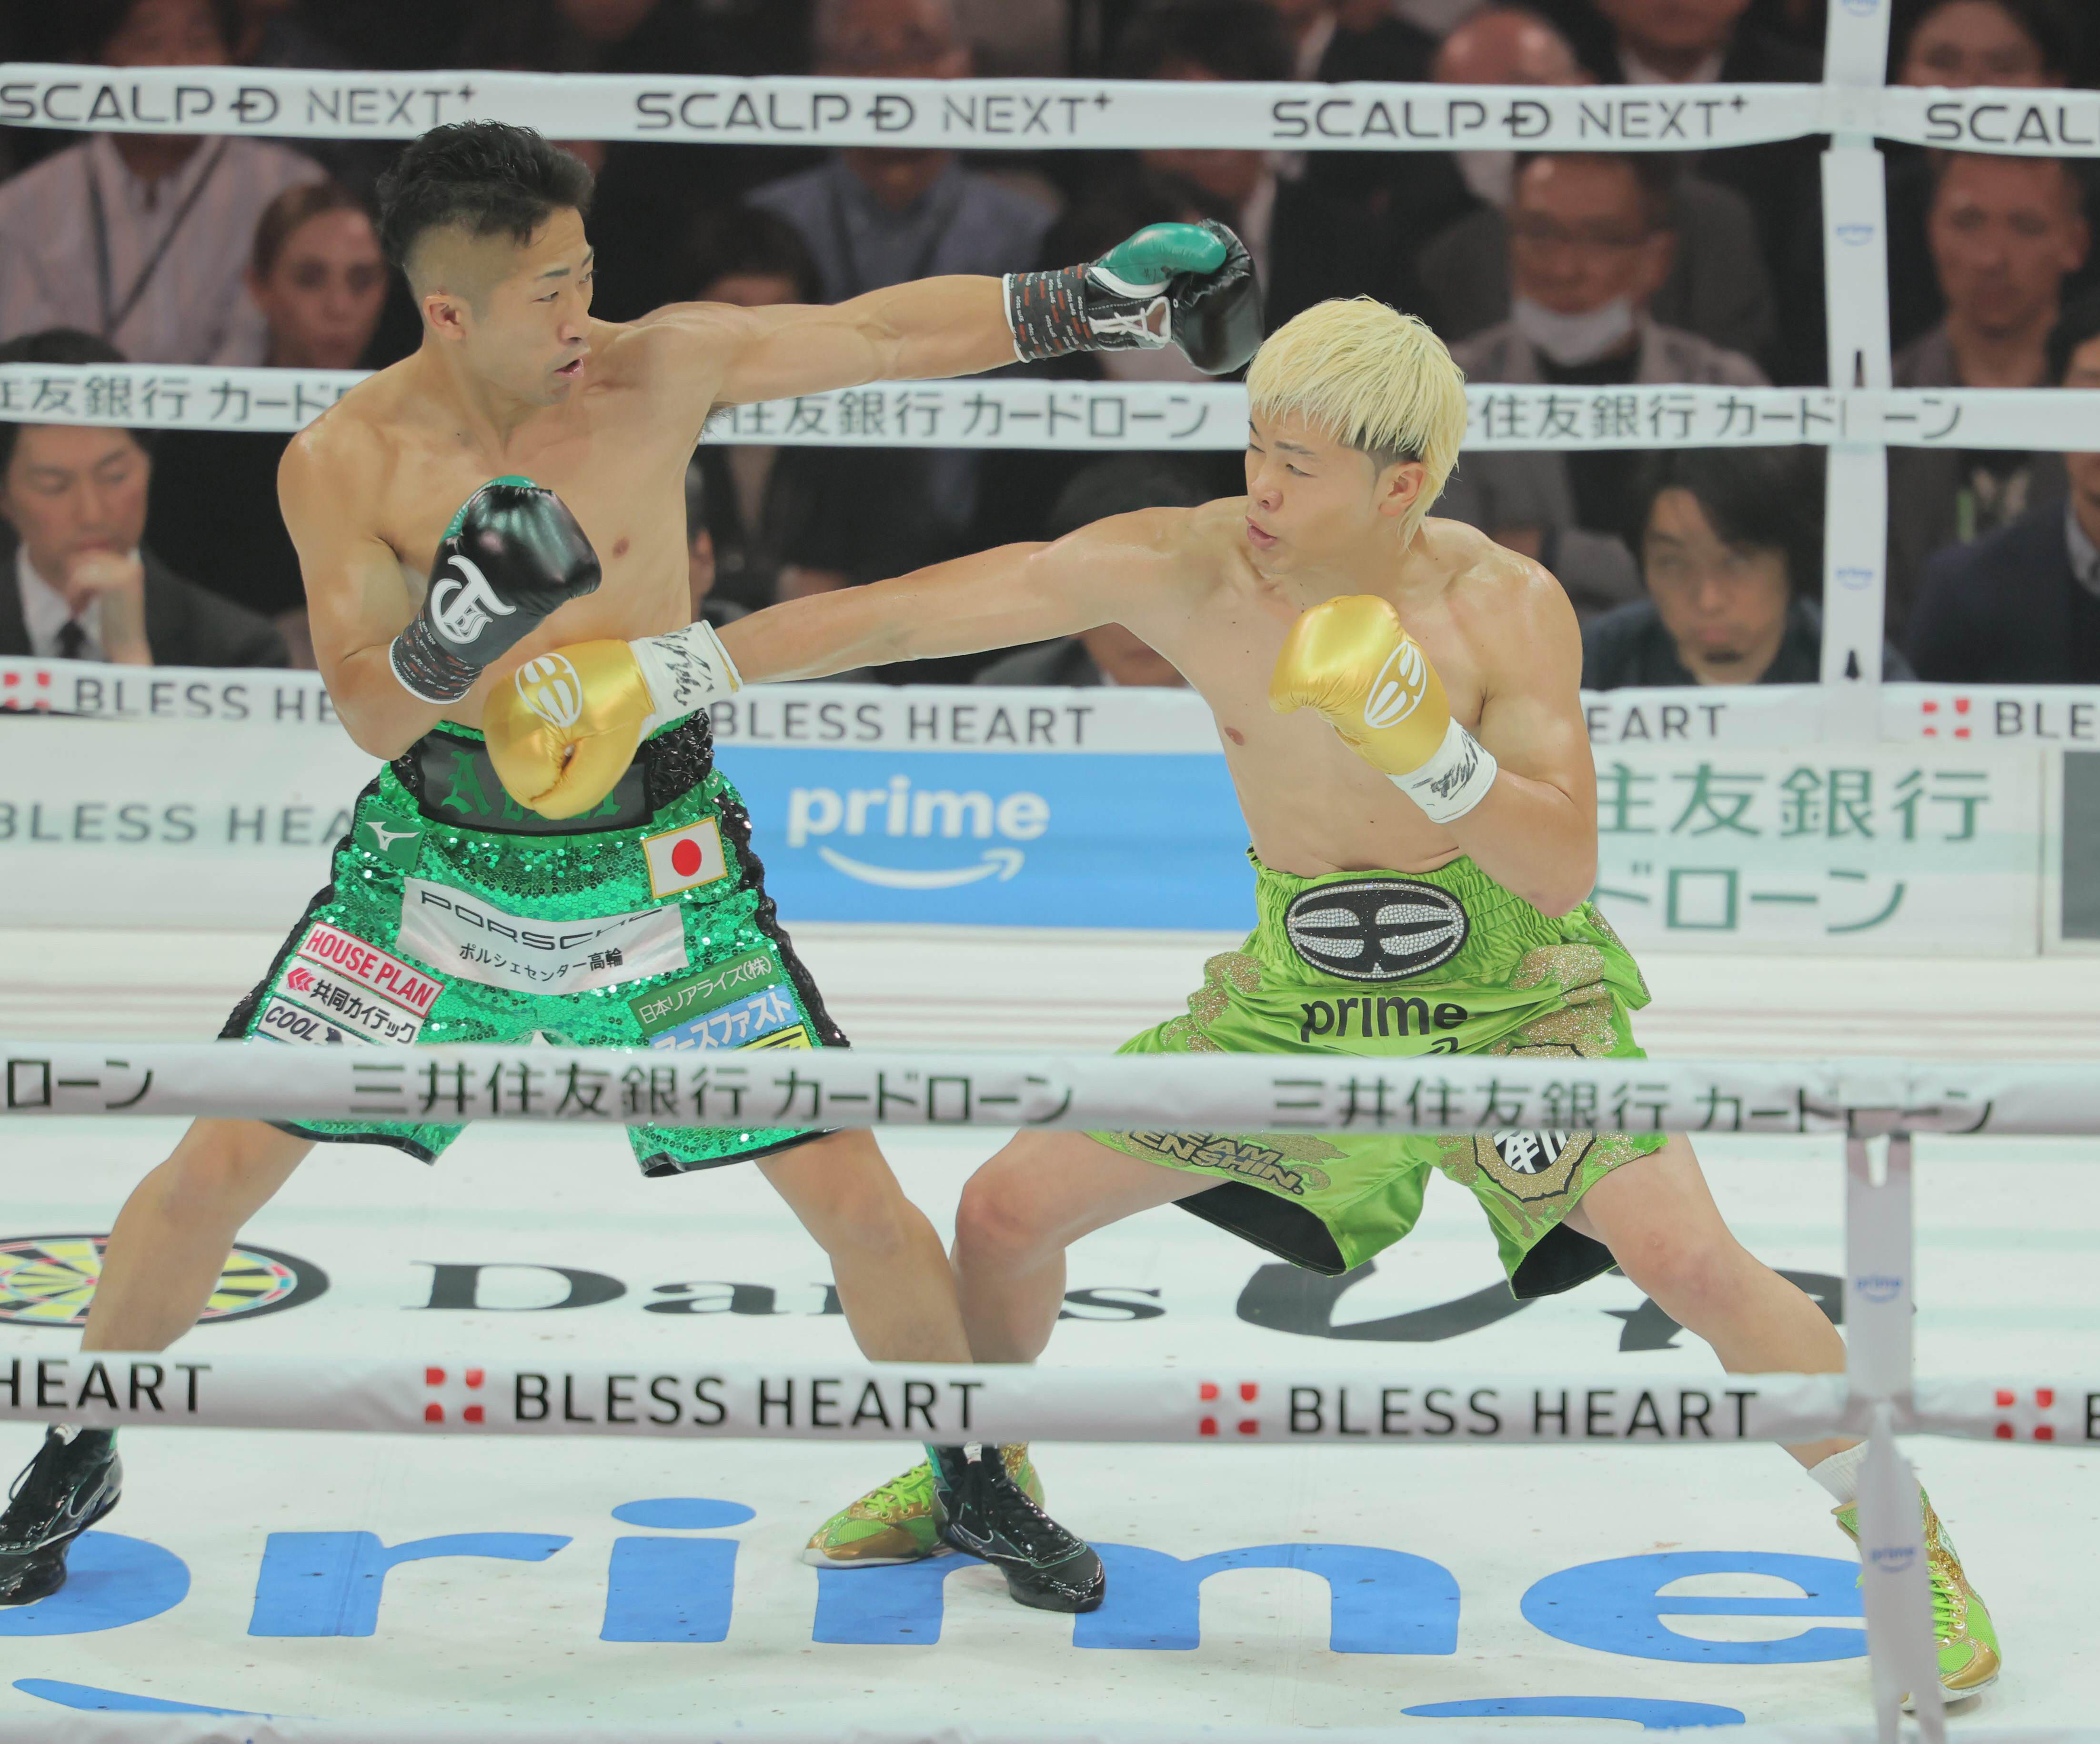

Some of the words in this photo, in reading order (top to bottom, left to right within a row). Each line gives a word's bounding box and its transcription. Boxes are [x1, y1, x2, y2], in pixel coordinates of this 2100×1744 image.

[636, 91, 851, 131] SCALP
[1271, 100, 1487, 139] SCALP
[1926, 103, 2098, 144] SCAL
[209, 380, 352, 423] カード
[962, 393, 1208, 439] カードローン
[1469, 394, 1696, 439] 住友銀行
[1716, 397, 1961, 440] カードーン
[75, 678, 250, 720] BLESS
[275, 687, 339, 723] HE
[710, 700, 883, 741] BLESS
[908, 703, 1095, 745] HEART
[1587, 703, 1728, 744] EART
[1996, 702, 2094, 739] BLE
[229, 807, 353, 846] HEA
[787, 774, 1049, 847] prime
[421, 890, 663, 951] PORSC
[305, 929, 379, 979] HOUSE
[374, 961, 435, 1008] PLAN
[459, 942, 623, 982] ポルシェセンター高輪
[310, 979, 417, 1045] 共同カイテック
[639, 955, 772, 1024] 日本リアライズ(株)
[265, 1006, 321, 1042] COOL
[1300, 992, 1468, 1042] prime
[350, 1060, 748, 1120] 三井住友銀行
[773, 1070, 1072, 1123] カードローン
[1271, 1076, 1668, 1130] 三井住友銀行
[1695, 1083, 1993, 1133] カードーン
[1129, 1130, 1304, 1195] ENSHIN.
[401, 1261, 1166, 1321] Das
[514, 1372, 727, 1427] BLESS
[761, 1377, 985, 1430] HEART
[1290, 1387, 1501, 1437] BLESS
[1533, 1389, 1758, 1439] HEART
